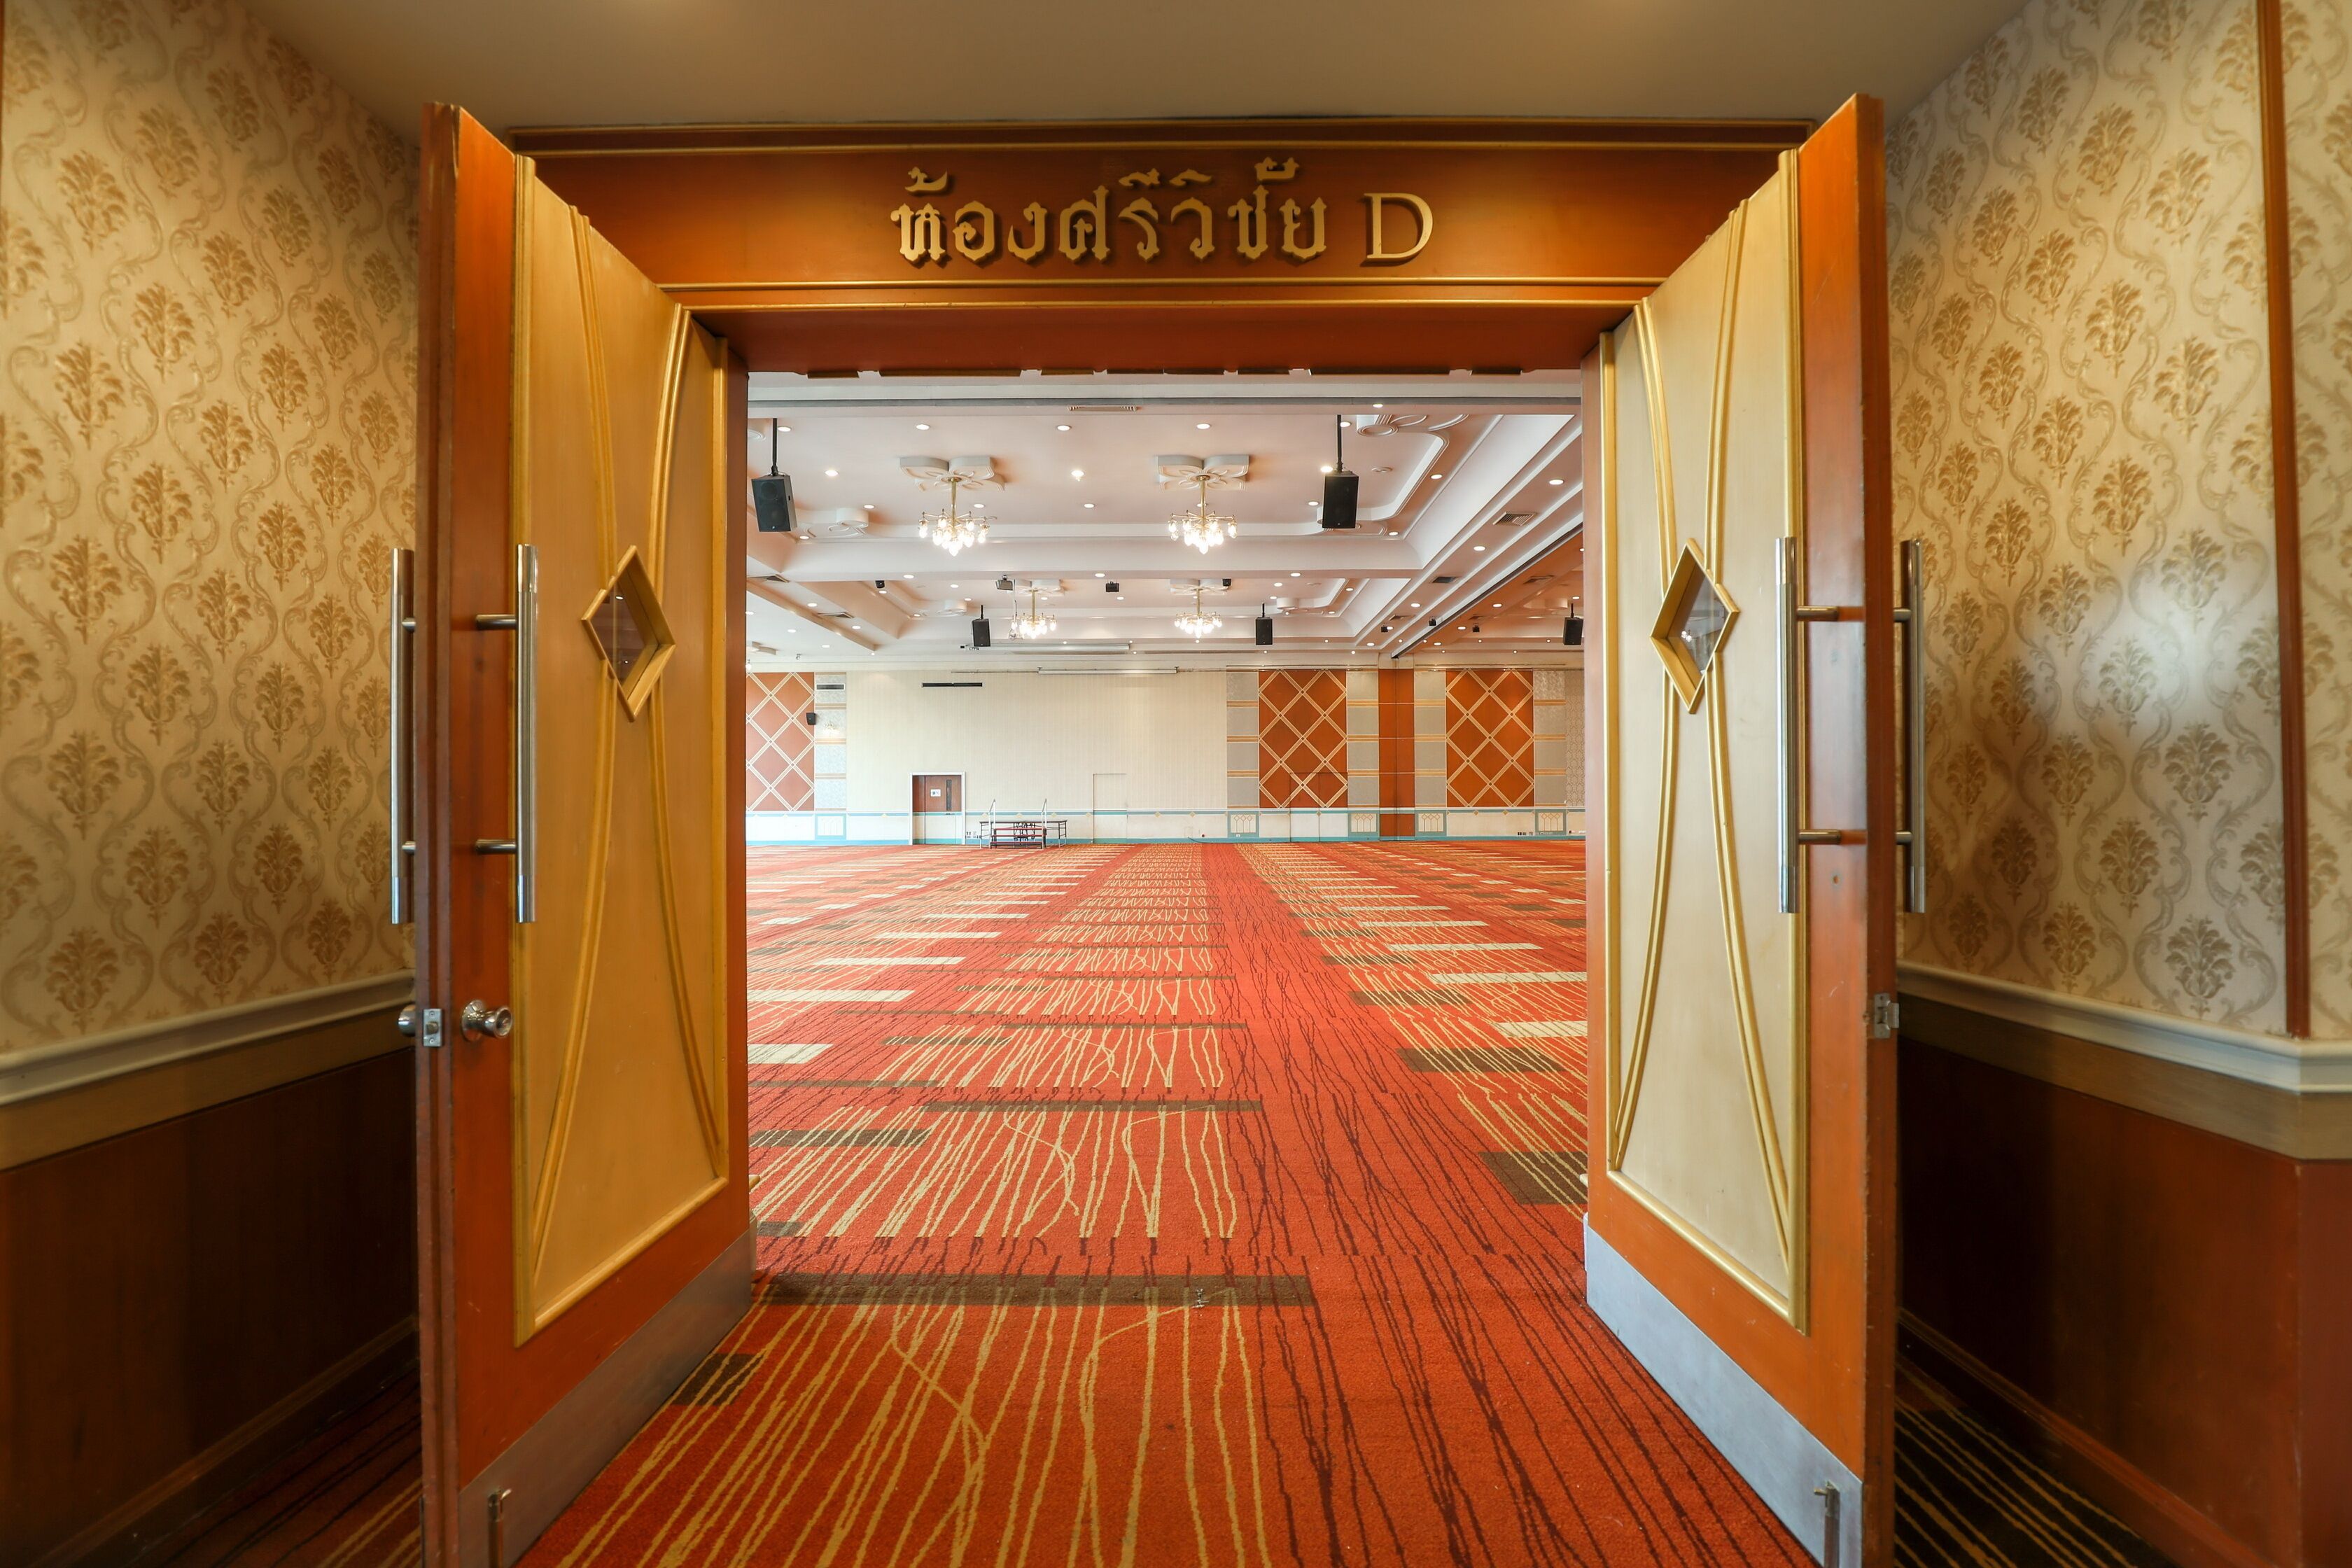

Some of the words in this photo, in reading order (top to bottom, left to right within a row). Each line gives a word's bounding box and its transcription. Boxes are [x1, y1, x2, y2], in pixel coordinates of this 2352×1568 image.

[890, 157, 1327, 262] ห้องศรีวิชัย
[1363, 192, 1434, 260] D
